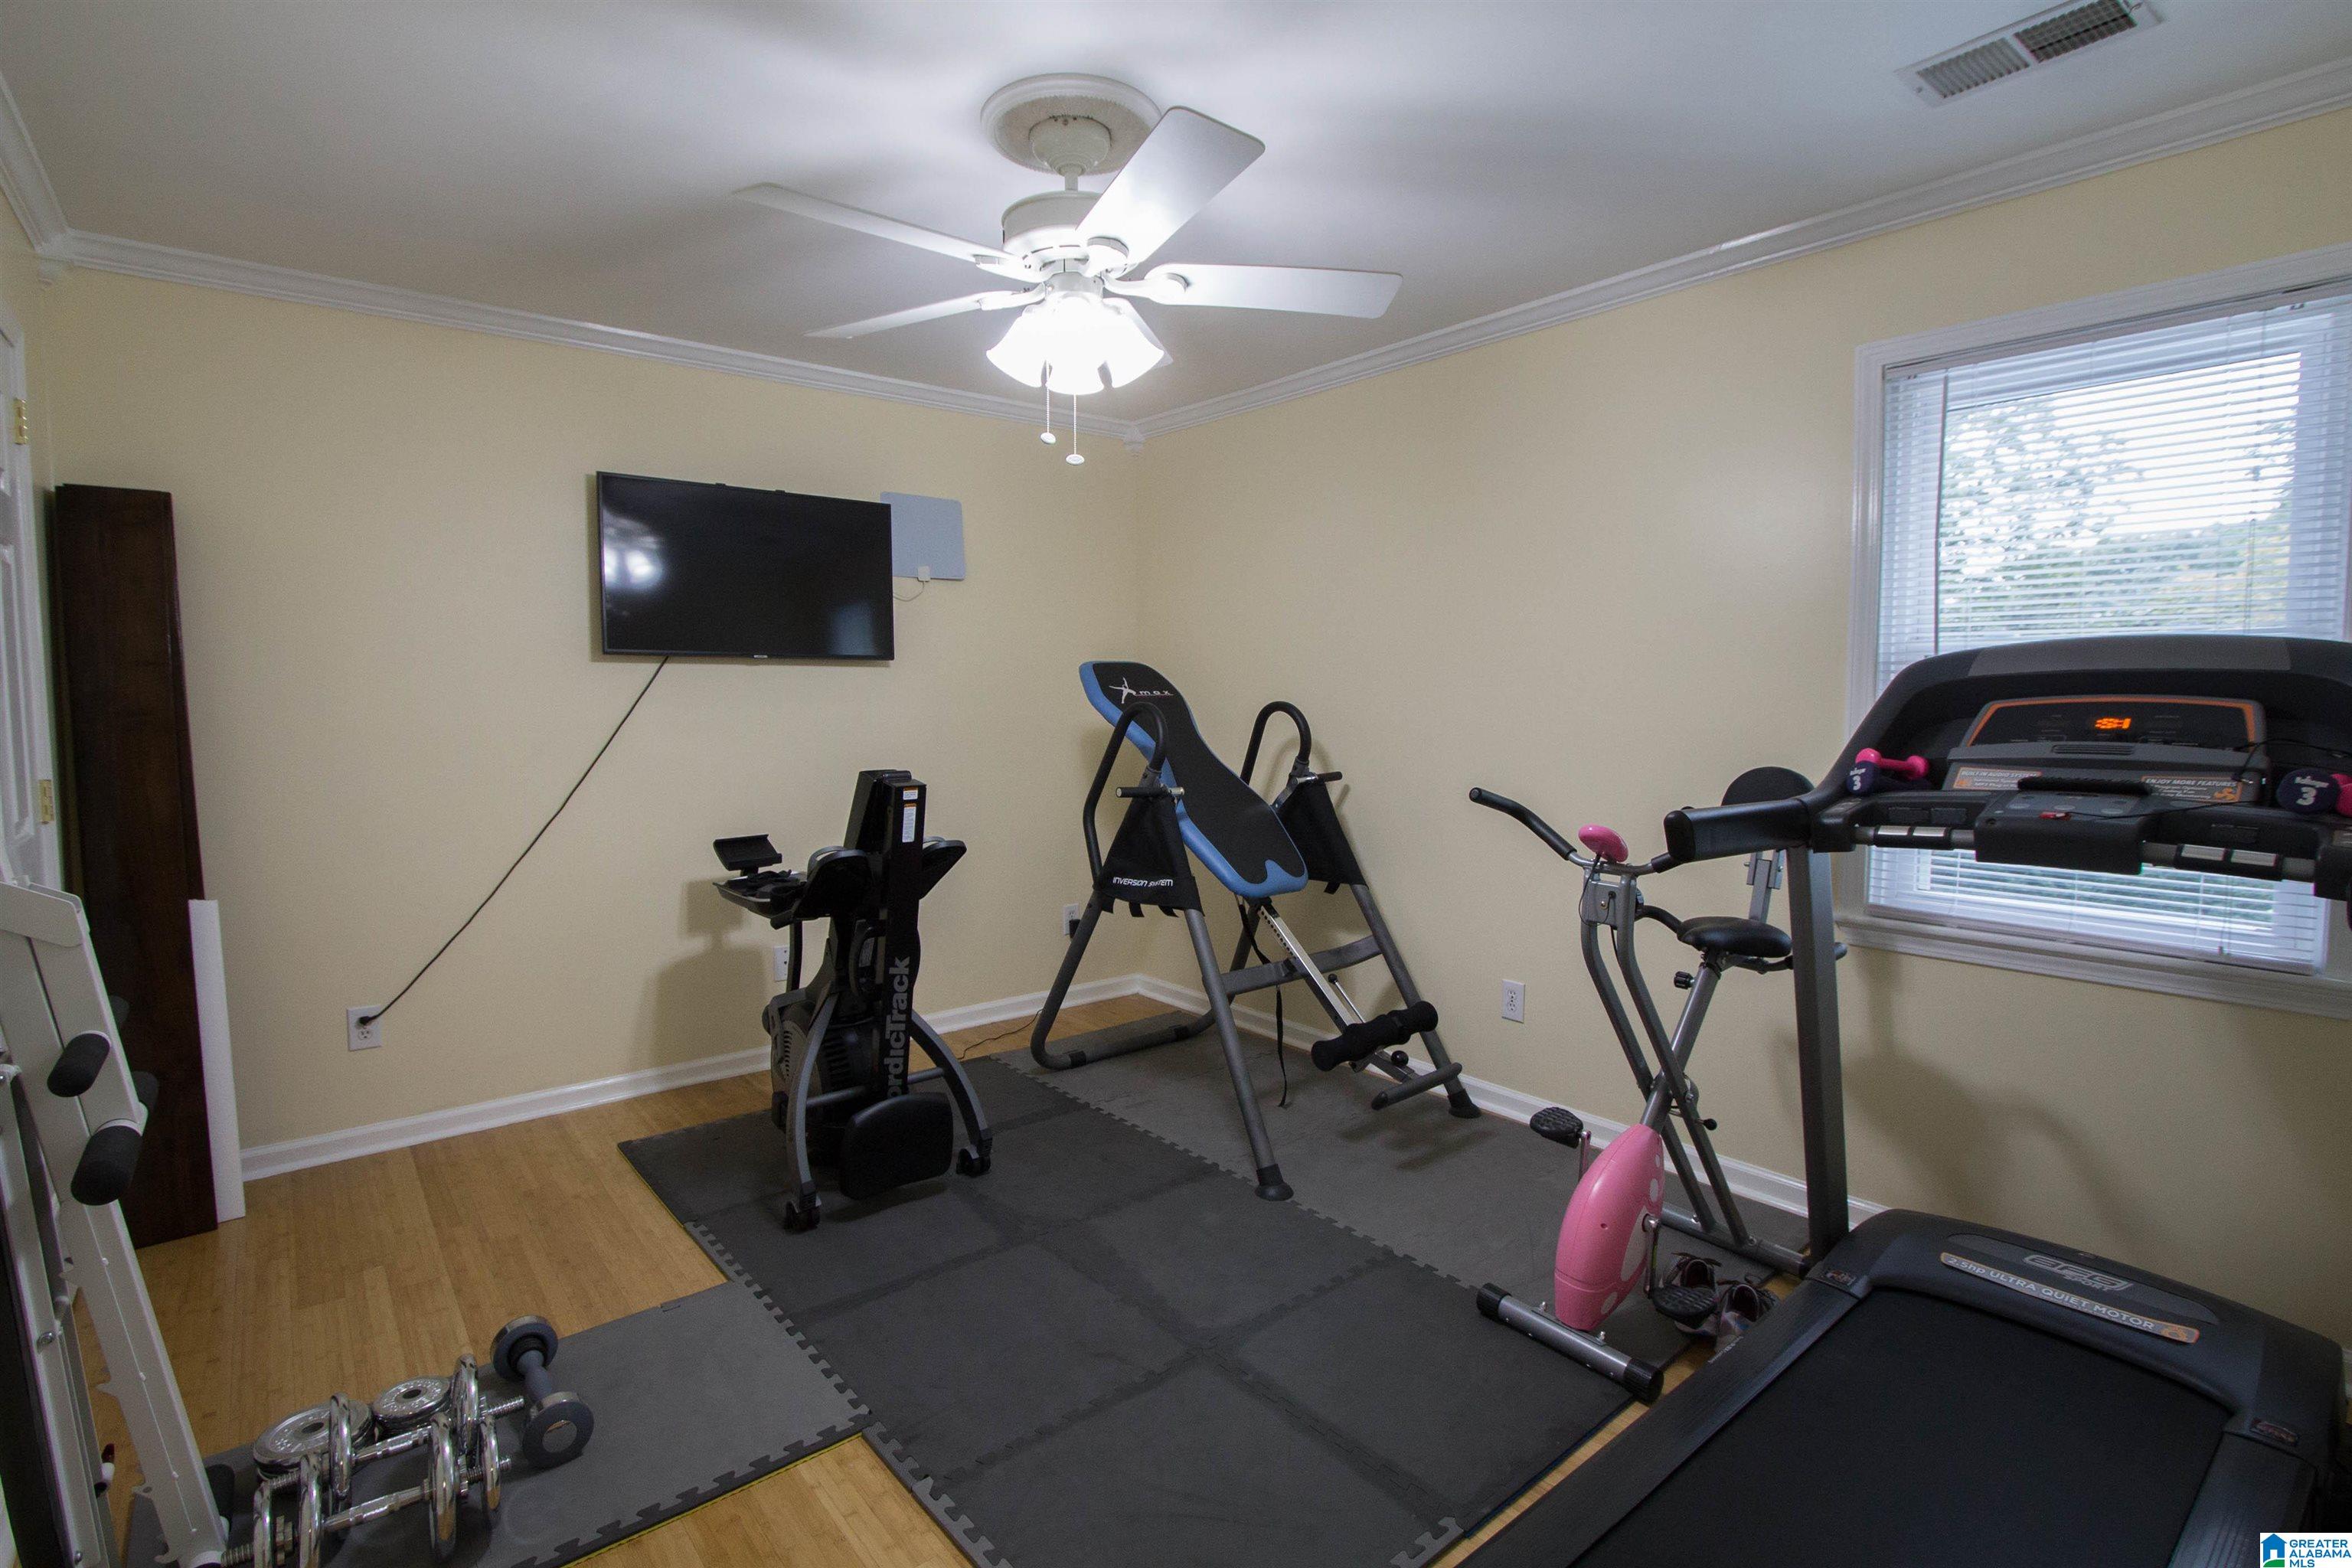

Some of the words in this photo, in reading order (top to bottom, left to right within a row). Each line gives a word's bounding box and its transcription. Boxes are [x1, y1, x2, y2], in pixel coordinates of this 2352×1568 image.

[1853, 775, 1861, 791] 3
[2296, 786, 2317, 805] 3
[884, 956, 910, 1100] ordicTrack
[1947, 1257, 1986, 1274] 2.5hp
[1989, 1270, 2036, 1291] ULTRA
[2040, 1287, 2090, 1308] QUIET
[2092, 1305, 2156, 1331] MOTOR
